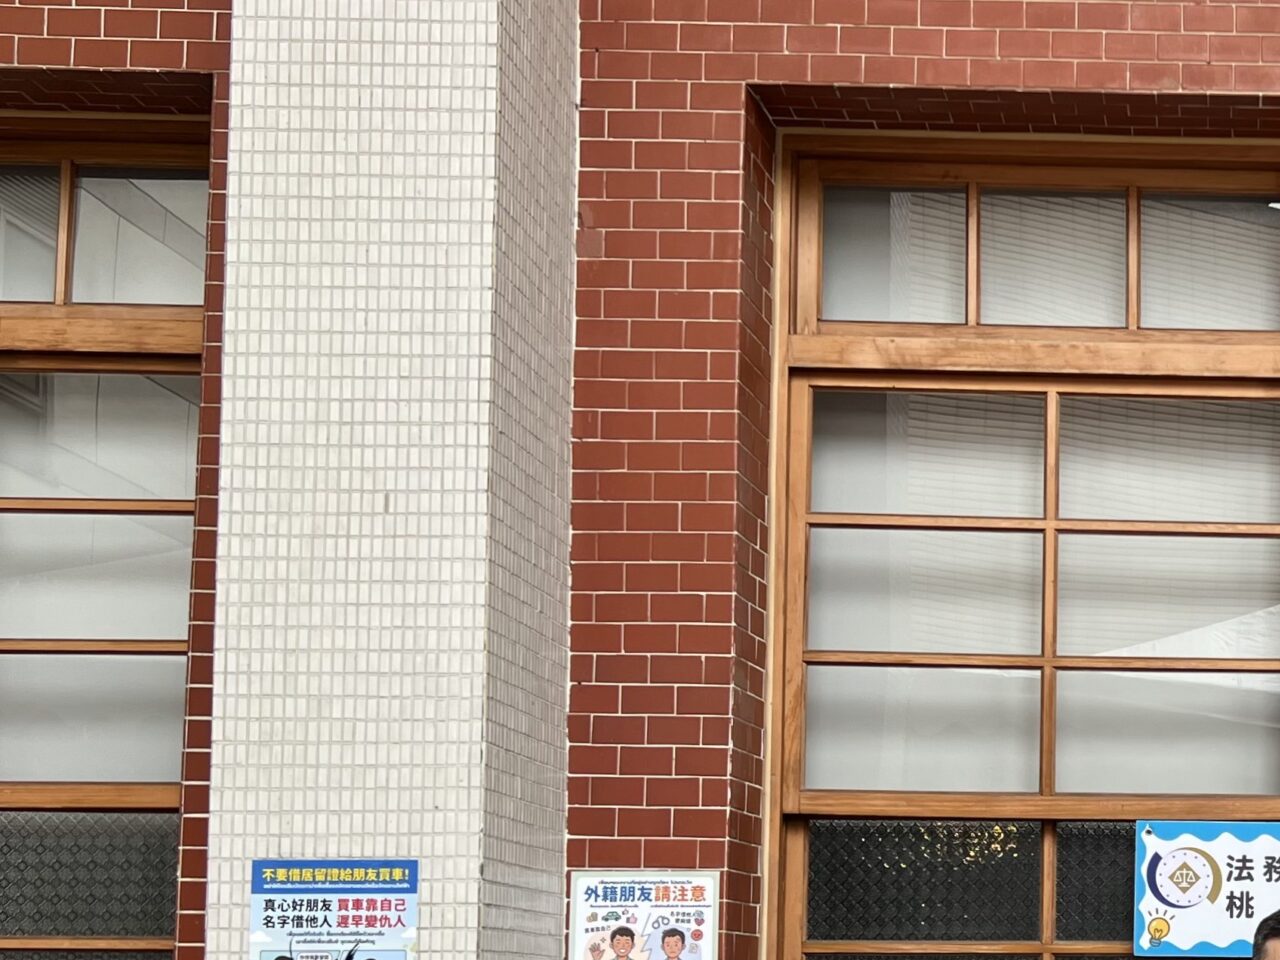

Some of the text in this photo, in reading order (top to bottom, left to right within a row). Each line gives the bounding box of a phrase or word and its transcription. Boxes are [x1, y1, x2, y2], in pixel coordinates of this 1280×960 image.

[262, 868, 409, 882] 不要借居留證給朋友買車!
[584, 885, 706, 903] 外籍朋友請注意
[263, 898, 406, 912] 真心好朋友 買車靠自己
[262, 914, 406, 928] 名字借他人 遲早變仇人
